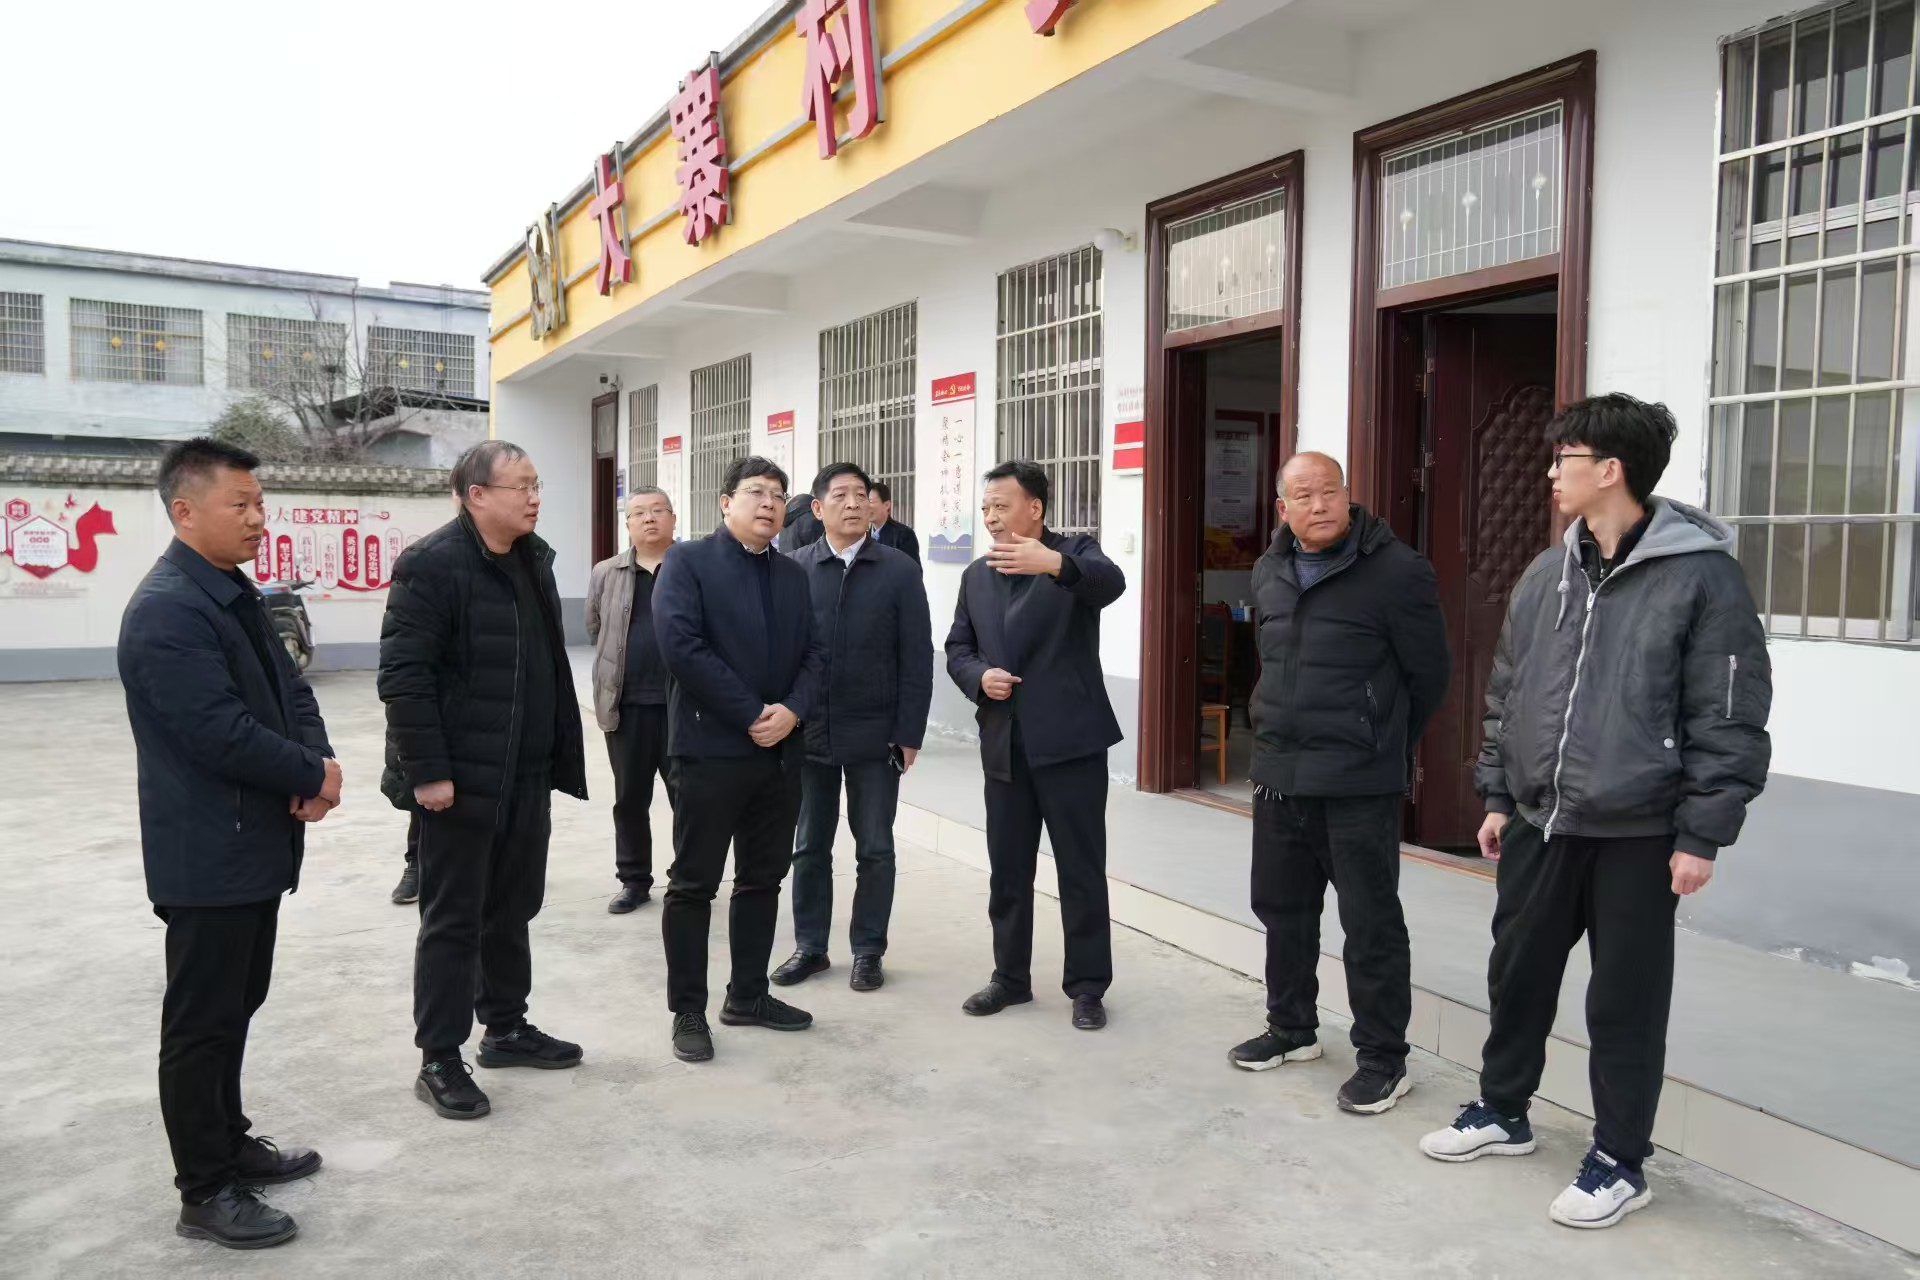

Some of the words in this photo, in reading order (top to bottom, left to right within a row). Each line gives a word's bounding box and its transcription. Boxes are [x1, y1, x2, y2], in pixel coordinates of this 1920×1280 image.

[953, 418, 963, 528] 一心一意谋发展
[264, 507, 358, 524] 大建党精神
[302, 536, 313, 573] 践行初心
[324, 543, 335, 579] 不怕牺牲
[346, 536, 357, 573] 英勇斗争
[368, 543, 378, 580] 对党忠诚
